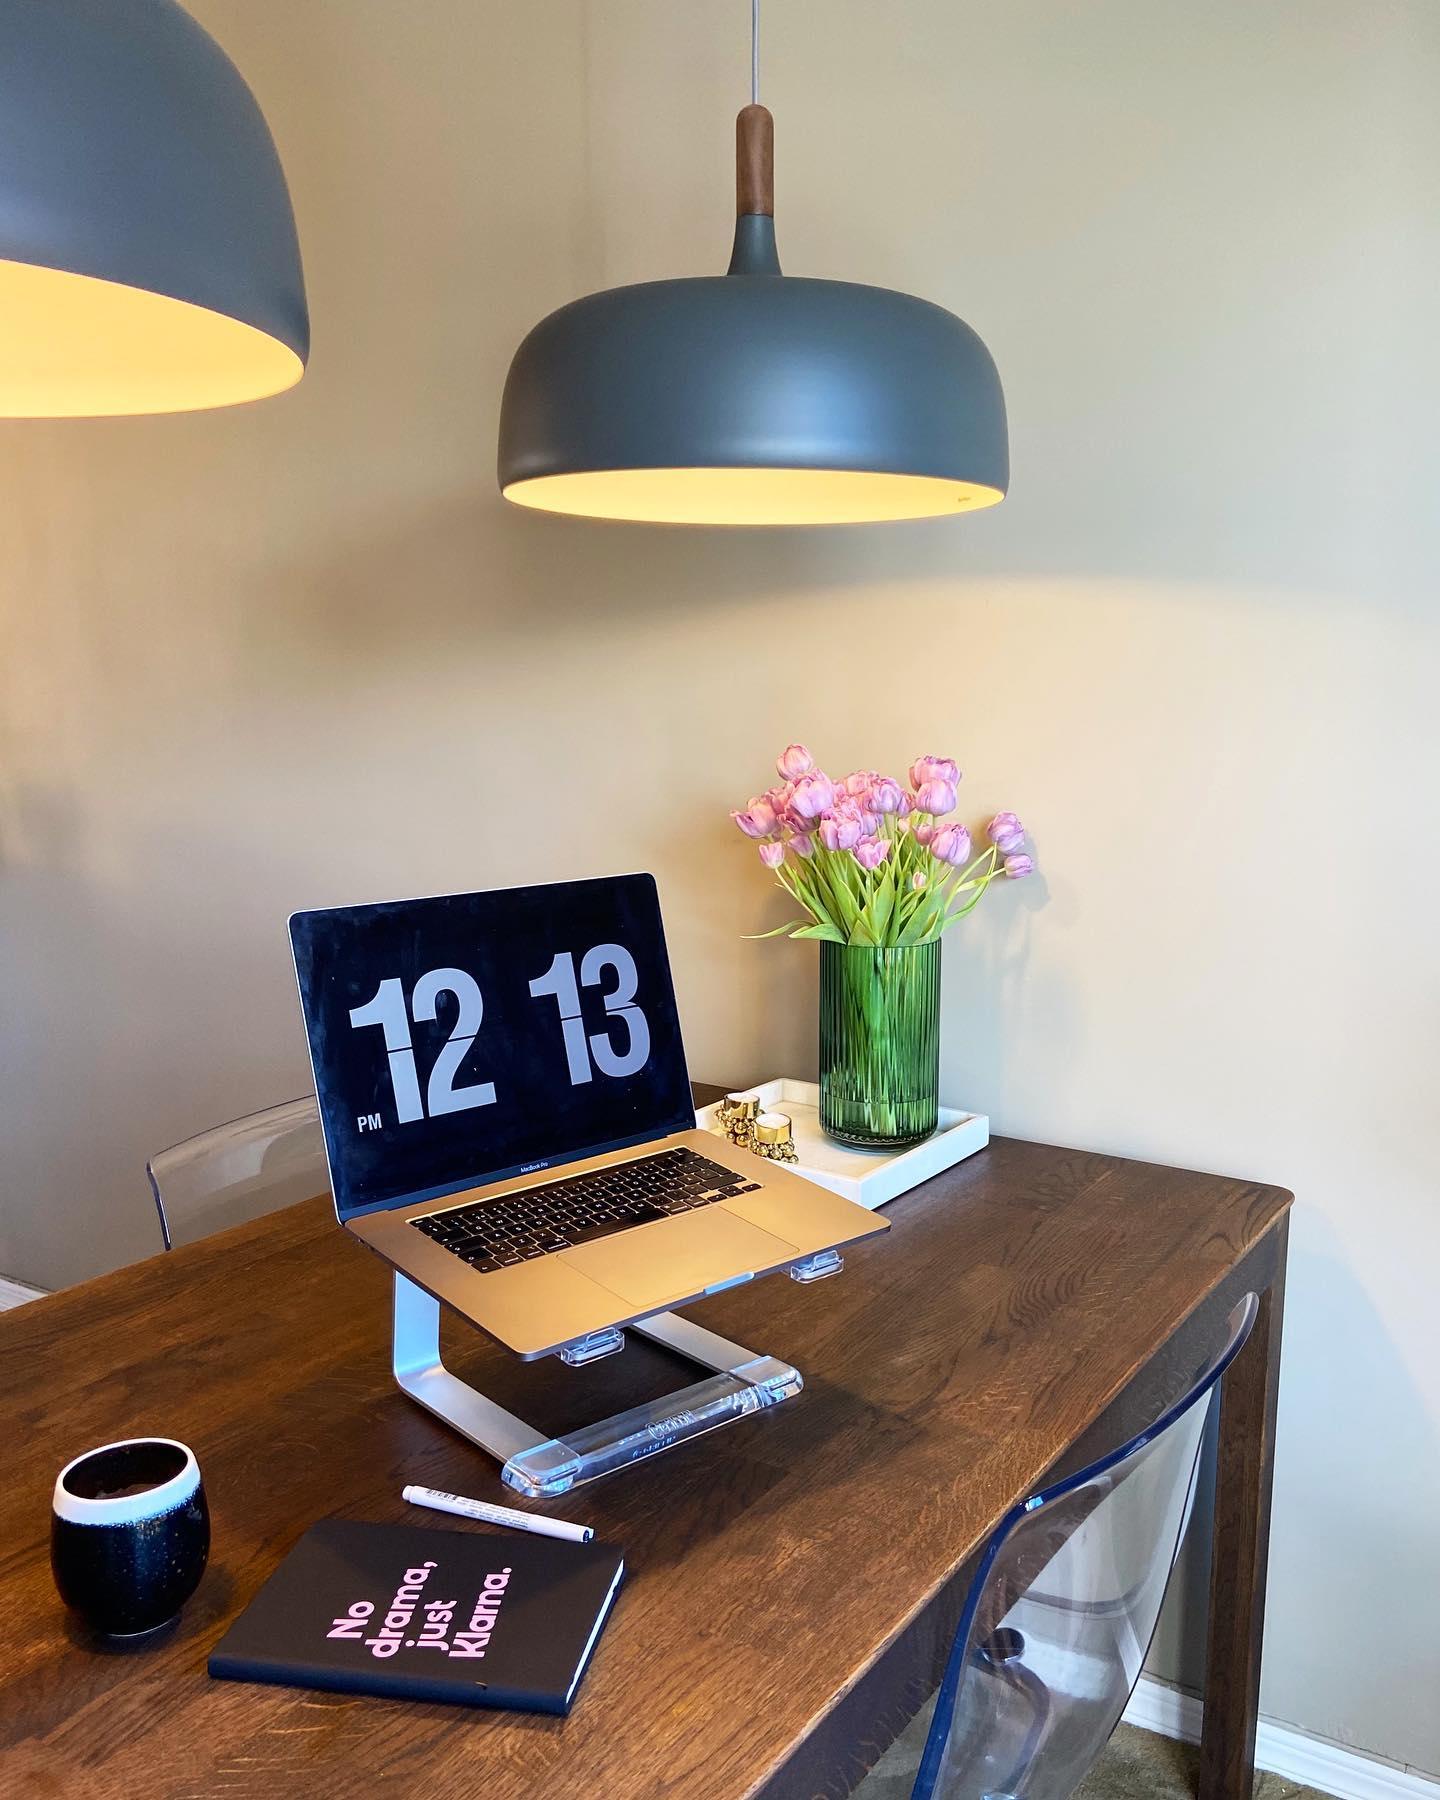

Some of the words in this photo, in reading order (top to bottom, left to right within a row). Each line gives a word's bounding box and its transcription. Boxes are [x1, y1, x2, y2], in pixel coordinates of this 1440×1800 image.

[349, 967, 497, 1124] 12
[528, 943, 651, 1086] 13
[357, 1112, 383, 1133] PM
[520, 1164, 541, 1173] MacBook
[326, 1601, 375, 1639] No
[364, 1561, 438, 1658] drama,
[405, 1600, 458, 1651] just
[448, 1567, 512, 1658] Klarna.
